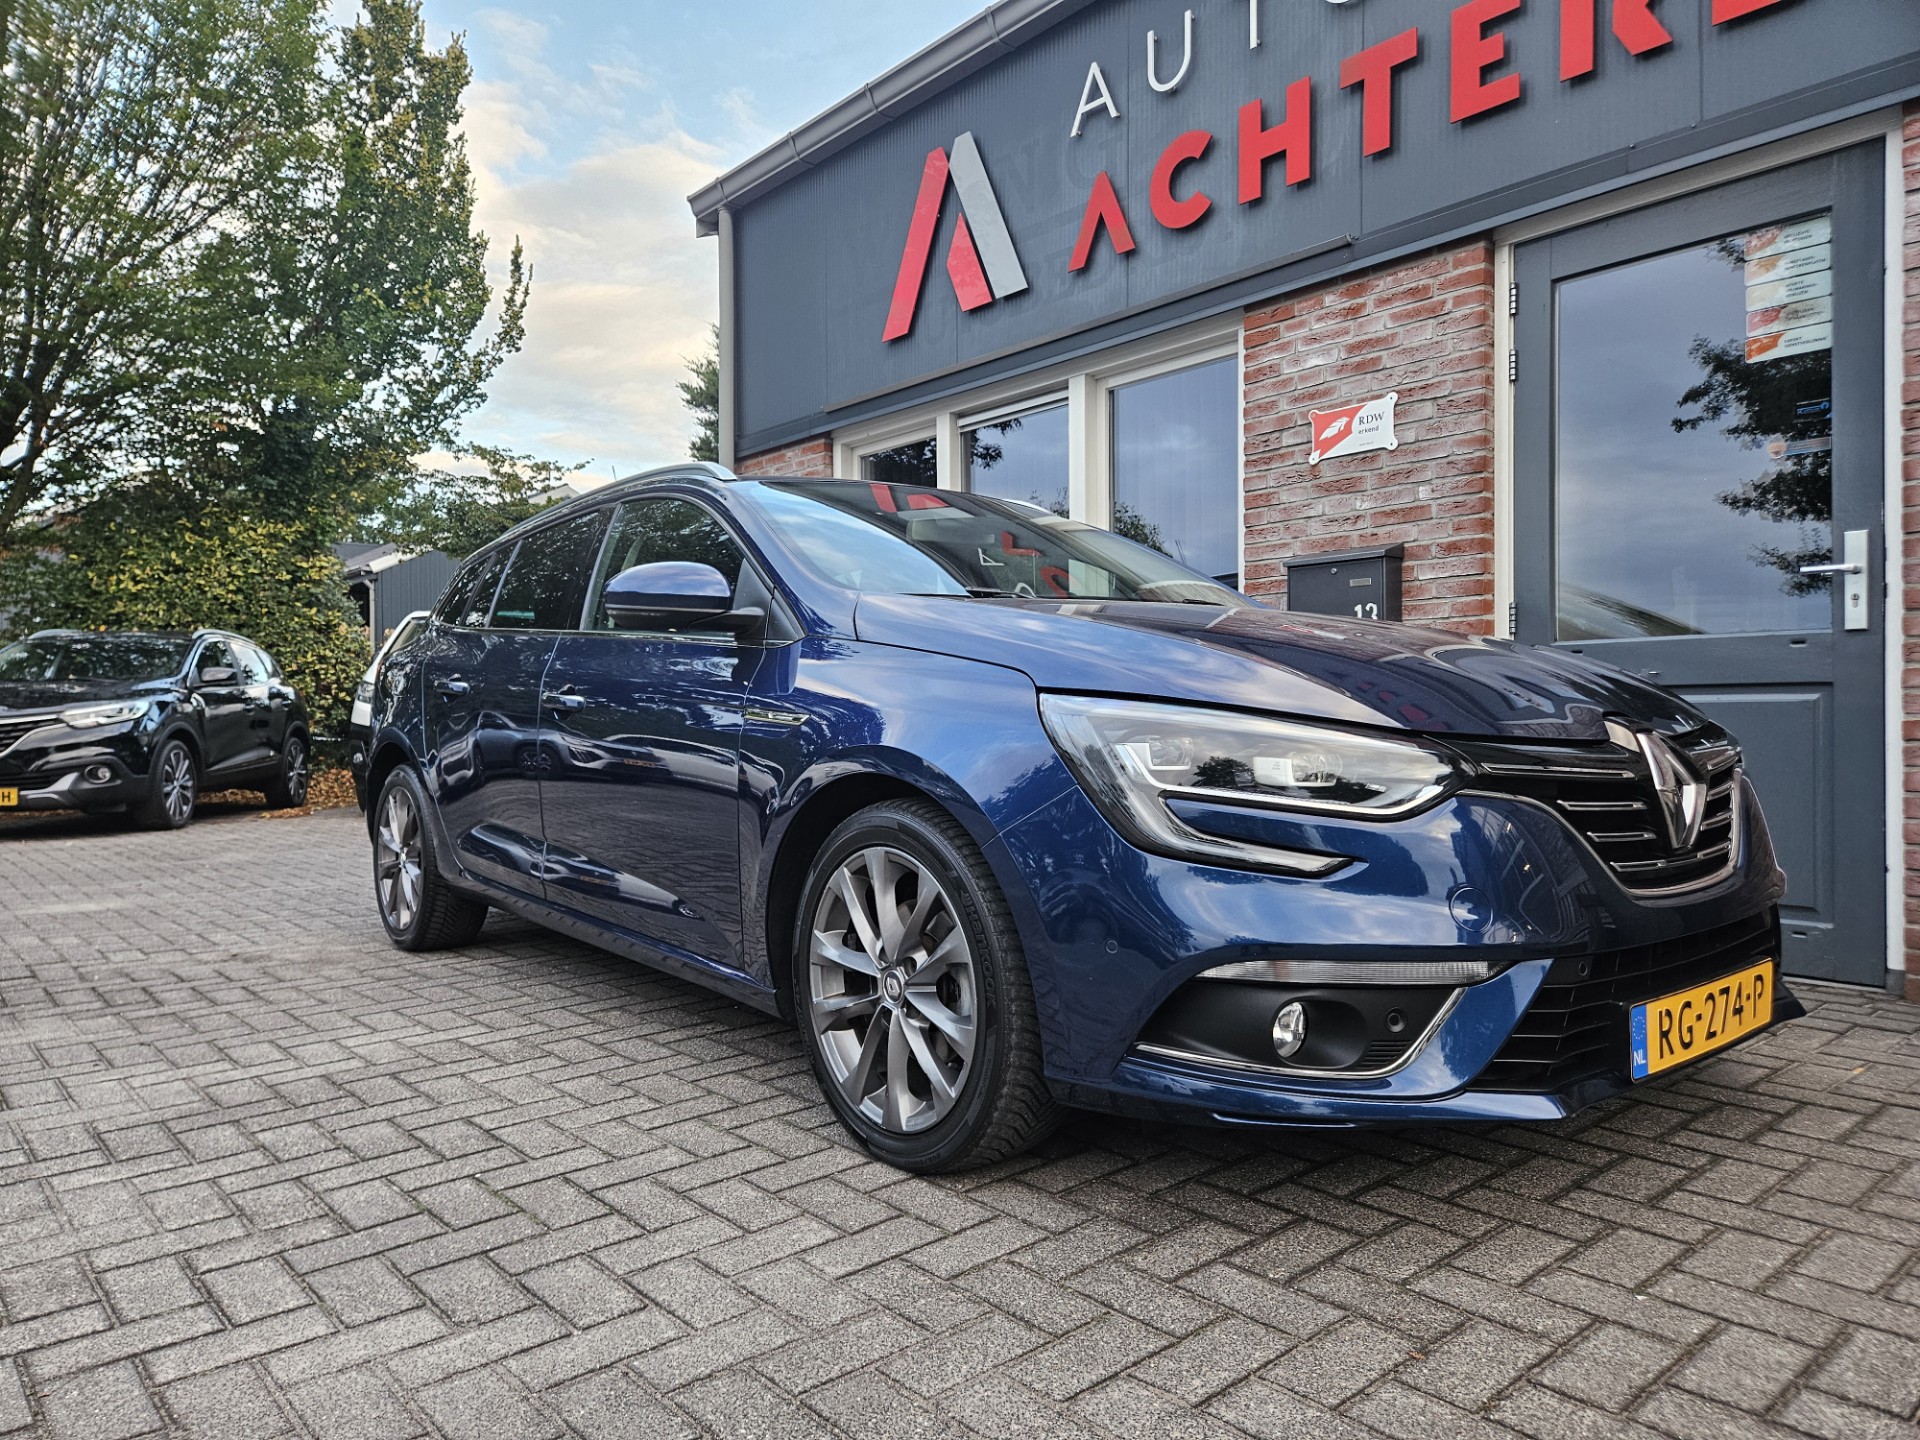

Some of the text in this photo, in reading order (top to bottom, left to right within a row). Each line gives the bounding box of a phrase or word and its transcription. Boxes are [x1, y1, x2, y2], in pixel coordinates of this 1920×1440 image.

[1070, 0, 1349, 138] AUT
[1067, 0, 1781, 273] ACHTER
[1358, 411, 1385, 426] RDW
[1358, 425, 1380, 434] erkend
[1657, 973, 1765, 1060] RG-274-P
[1633, 1049, 1647, 1067] NL
